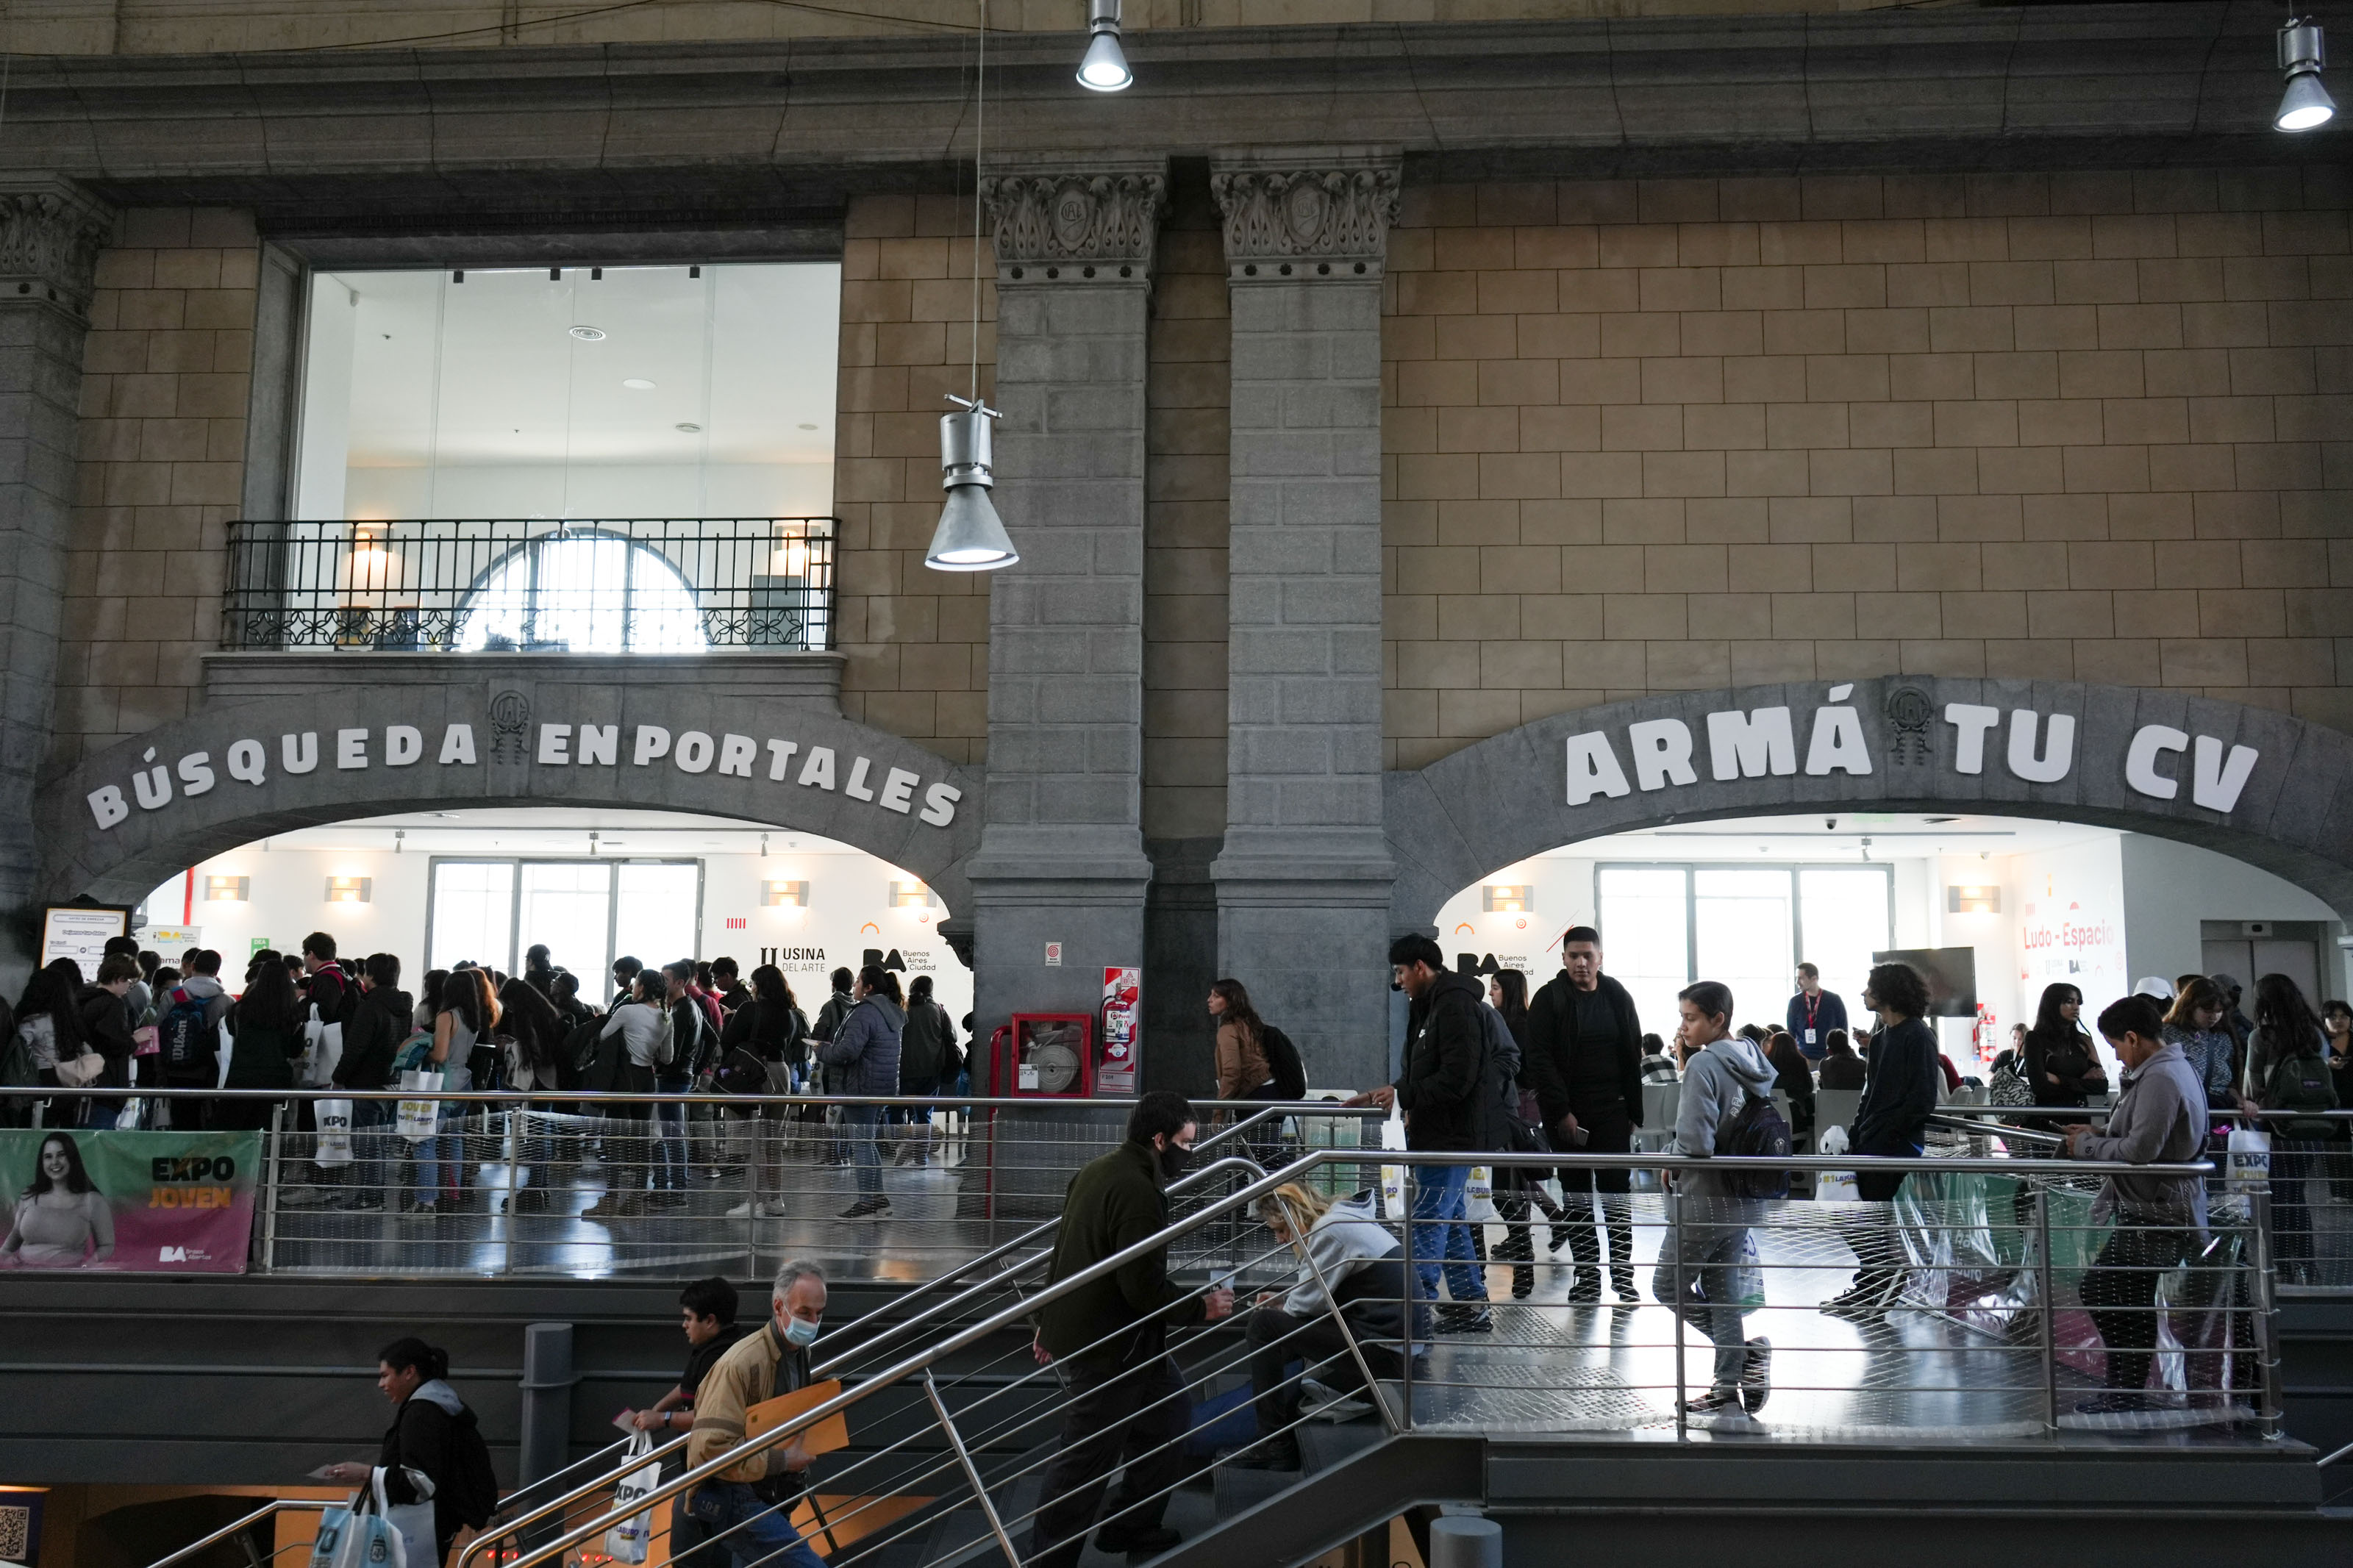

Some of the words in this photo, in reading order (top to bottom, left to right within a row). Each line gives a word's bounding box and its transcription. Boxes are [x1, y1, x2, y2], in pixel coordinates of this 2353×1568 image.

[1567, 684, 1873, 806] ARMÁ
[1945, 704, 2076, 783] TU
[2127, 725, 2259, 813] CV
[88, 724, 476, 829] BÚSQUEDA
[538, 724, 618, 765] EN
[634, 725, 962, 827] PORTALES
[2024, 924, 2052, 950] Ludo
[2063, 919, 2114, 952] Espacio
[783, 948, 826, 960] USINA
[782, 963, 799, 973] DEL
[801, 963, 826, 973] ARTE
[172, 1019, 188, 1061] Wilson
[324, 1116, 347, 1127] XPO
[152, 1156, 235, 1182] EXPO
[149, 1186, 232, 1209] JOVEN
[159, 1246, 186, 1262] BA
[615, 1484, 647, 1501] XPO
